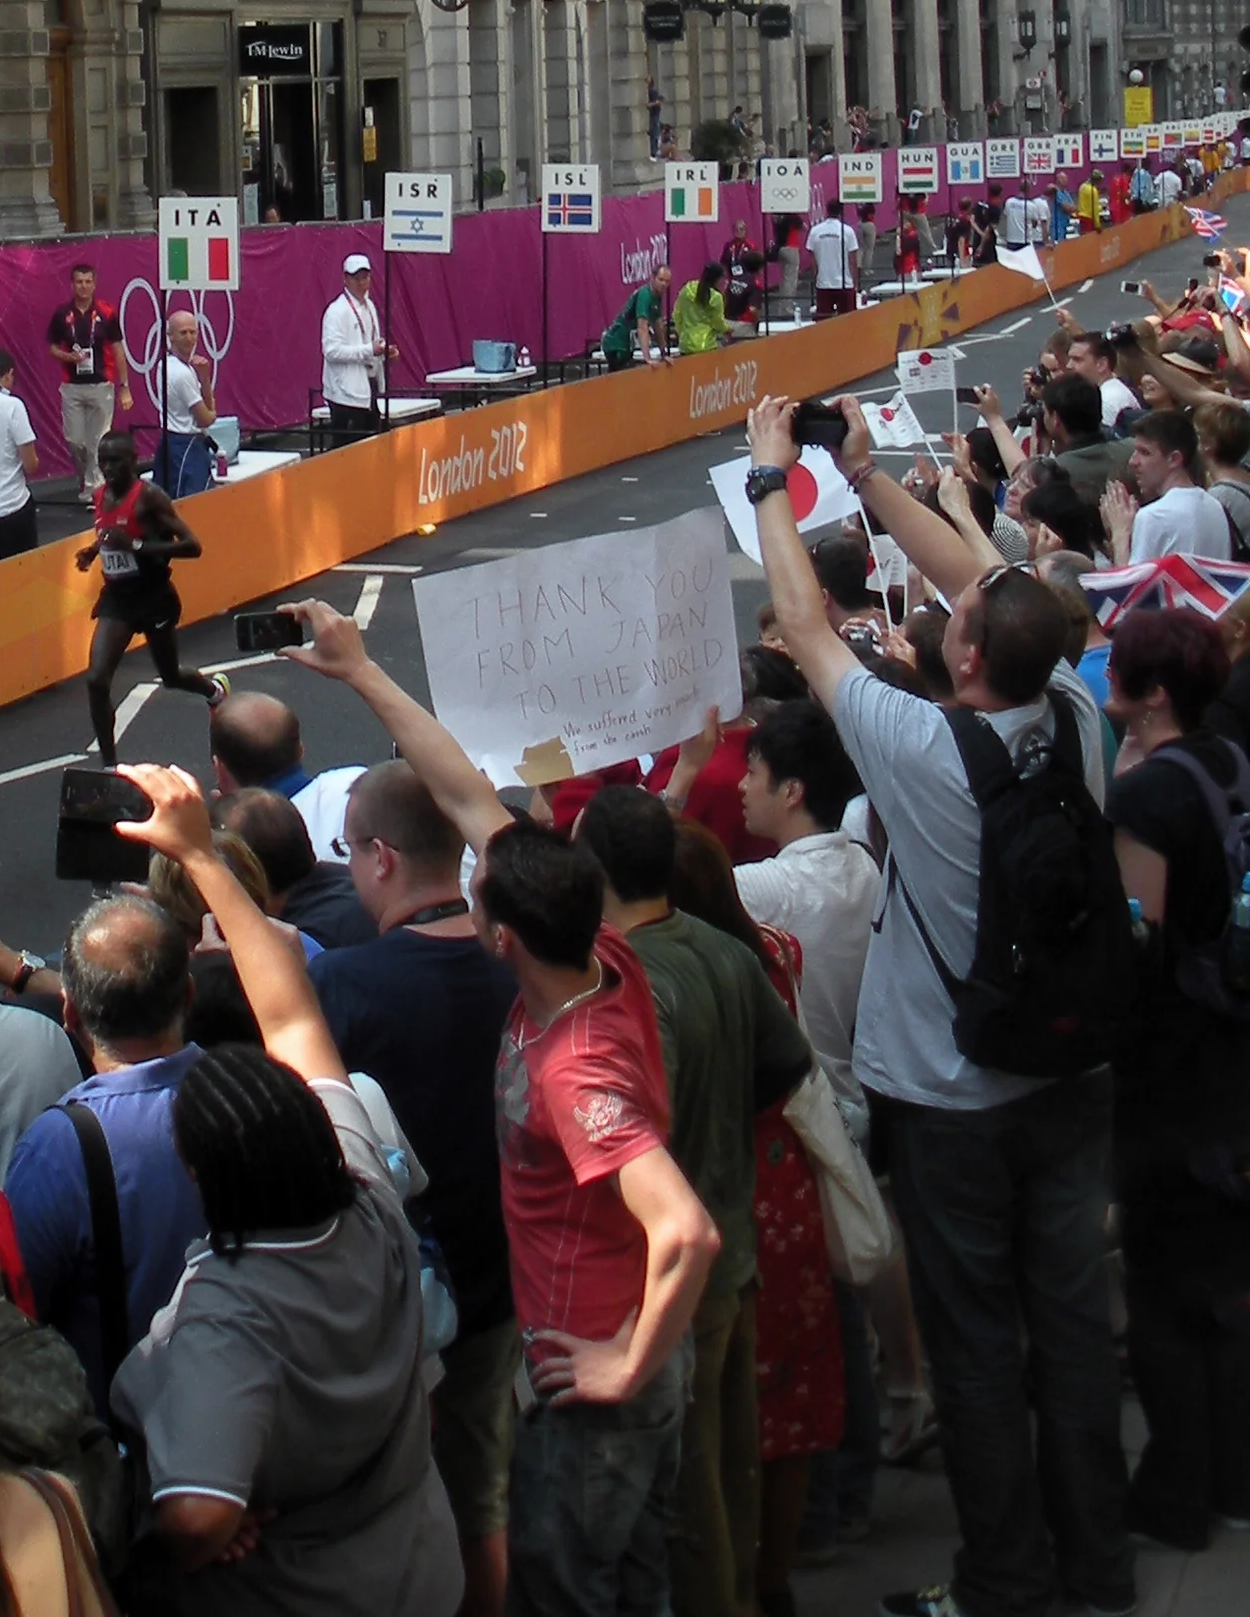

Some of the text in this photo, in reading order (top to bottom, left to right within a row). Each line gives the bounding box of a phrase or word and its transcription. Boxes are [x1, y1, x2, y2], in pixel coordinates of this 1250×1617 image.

[990, 144, 1015, 152] GRE
[1027, 142, 1051, 150] GBR
[1057, 138, 1078, 146] FRA
[901, 152, 934, 163] HUN
[950, 147, 980, 157] GUA
[766, 165, 803, 177] IOA
[844, 161, 874, 172] IND
[554, 172, 587, 186] ISL
[676, 169, 707, 181] IRL
[398, 182, 438, 200] ISR
[173, 208, 222, 226] ITA
[620, 237, 652, 284] London
[689, 360, 757, 418] London 2012
[417, 420, 528, 505] London 2012
[467, 557, 715, 641] THANK YOU
[476, 601, 710, 689] FROM JAPAN
[514, 638, 724, 721] TO THE WORLD
[588, 709, 638, 731] suffered
[646, 704, 672, 718] very
